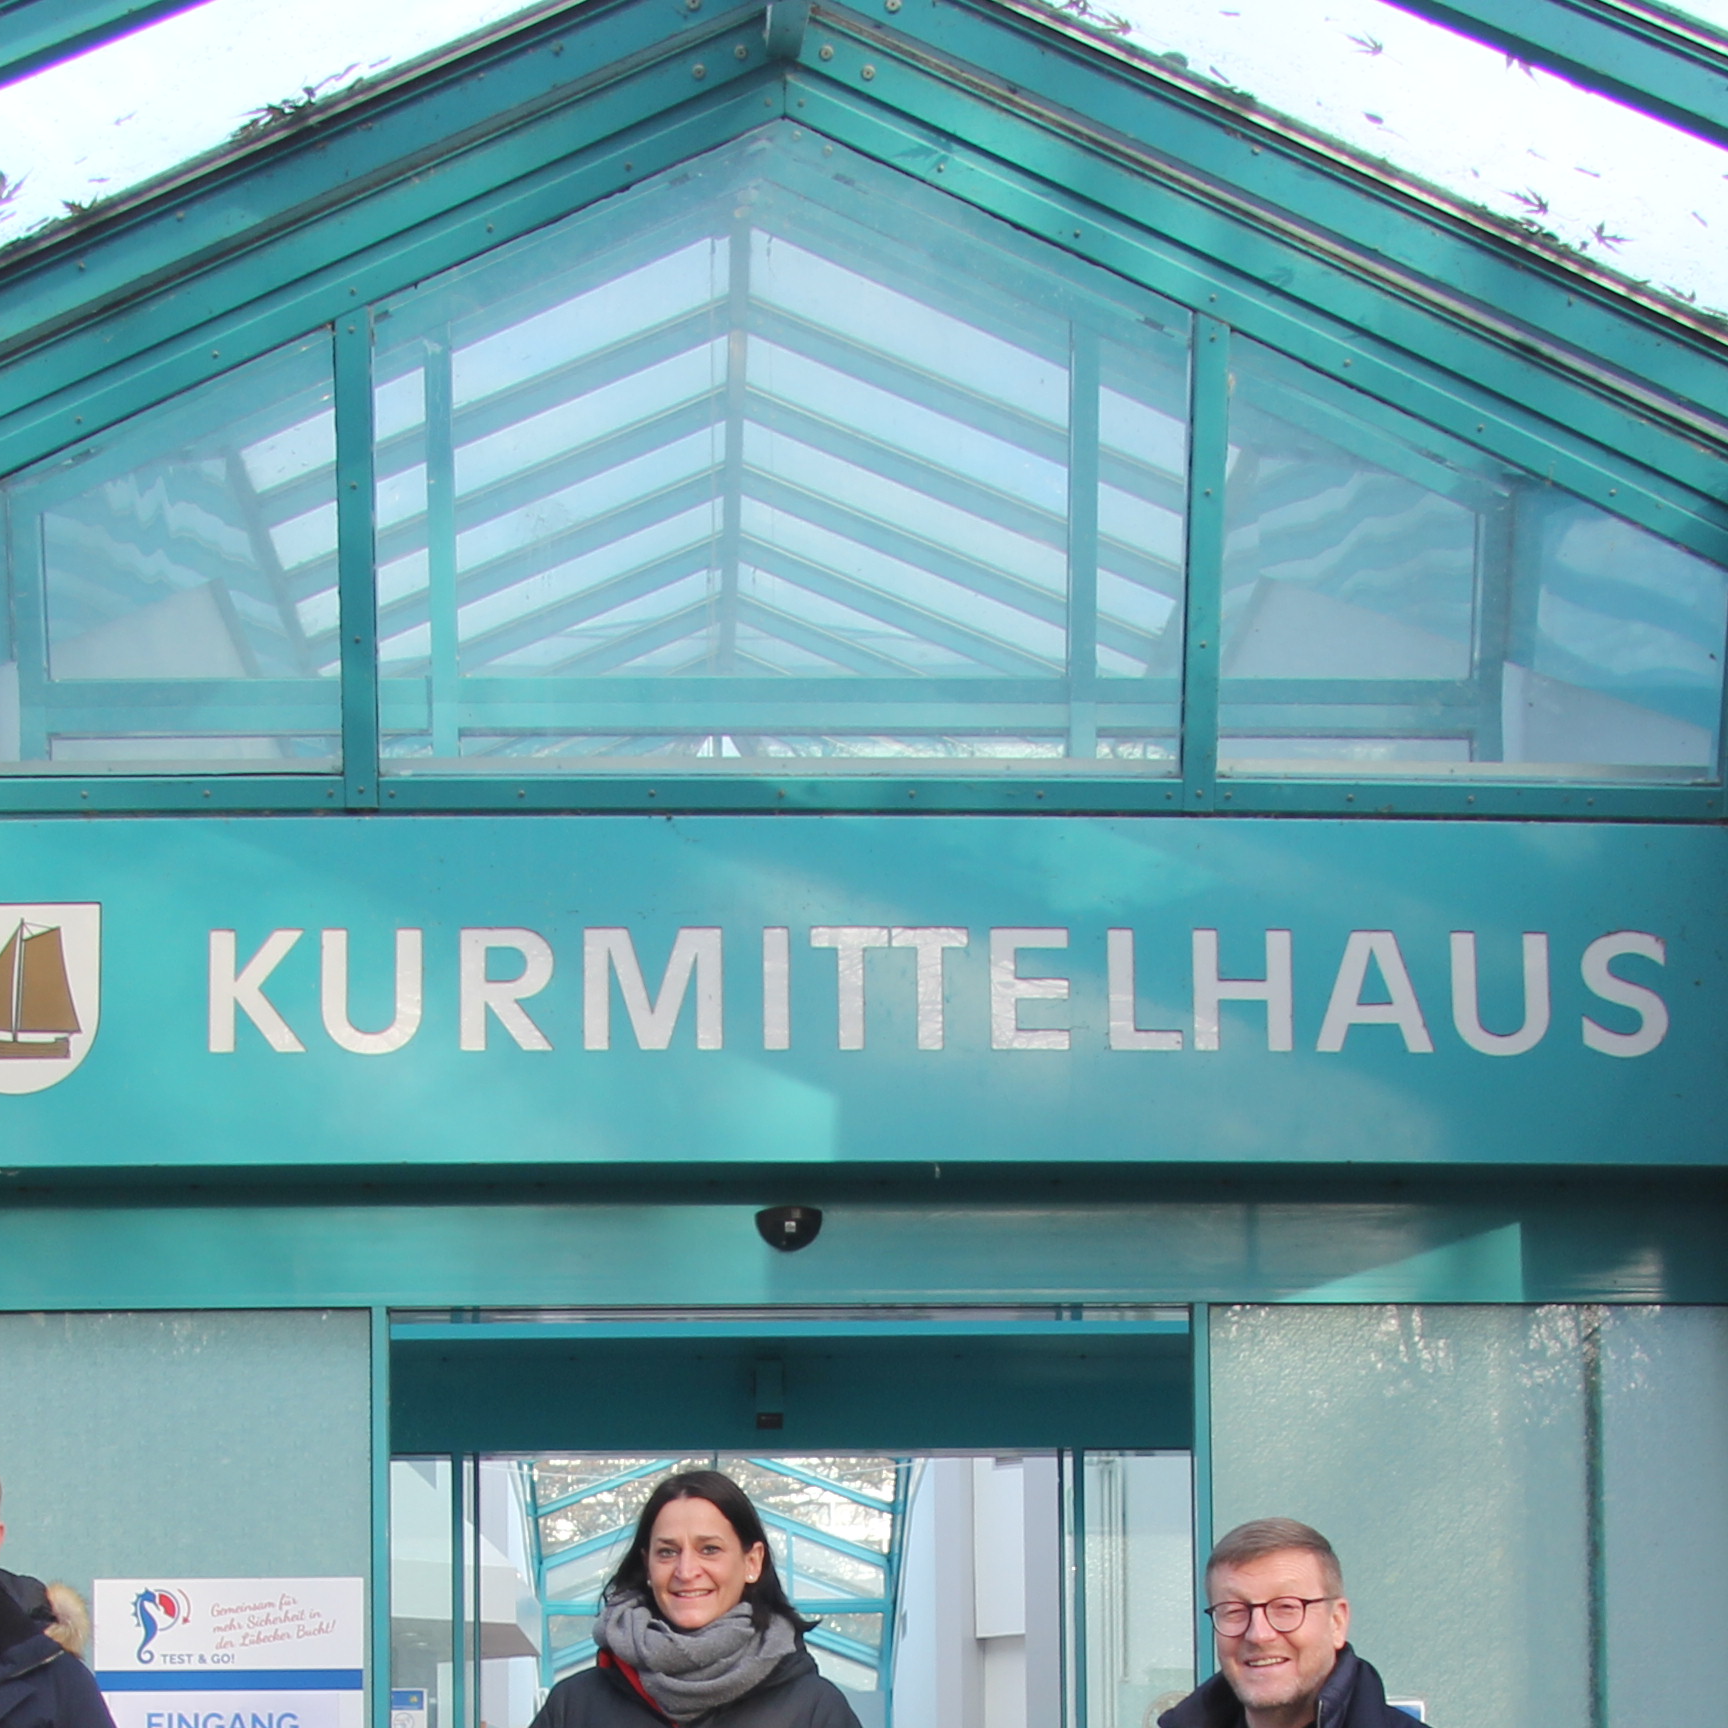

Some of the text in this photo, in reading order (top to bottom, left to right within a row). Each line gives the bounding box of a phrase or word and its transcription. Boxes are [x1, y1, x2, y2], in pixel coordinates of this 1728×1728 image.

[209, 926, 1670, 1056] KURMITTELHAUS
[211, 1593, 298, 1618] Gemeinsam für
[213, 1608, 322, 1634] mehr Sicherheit in
[215, 1619, 336, 1650] der Lübecker Bucht!
[161, 1653, 235, 1665] TEST & GO!
